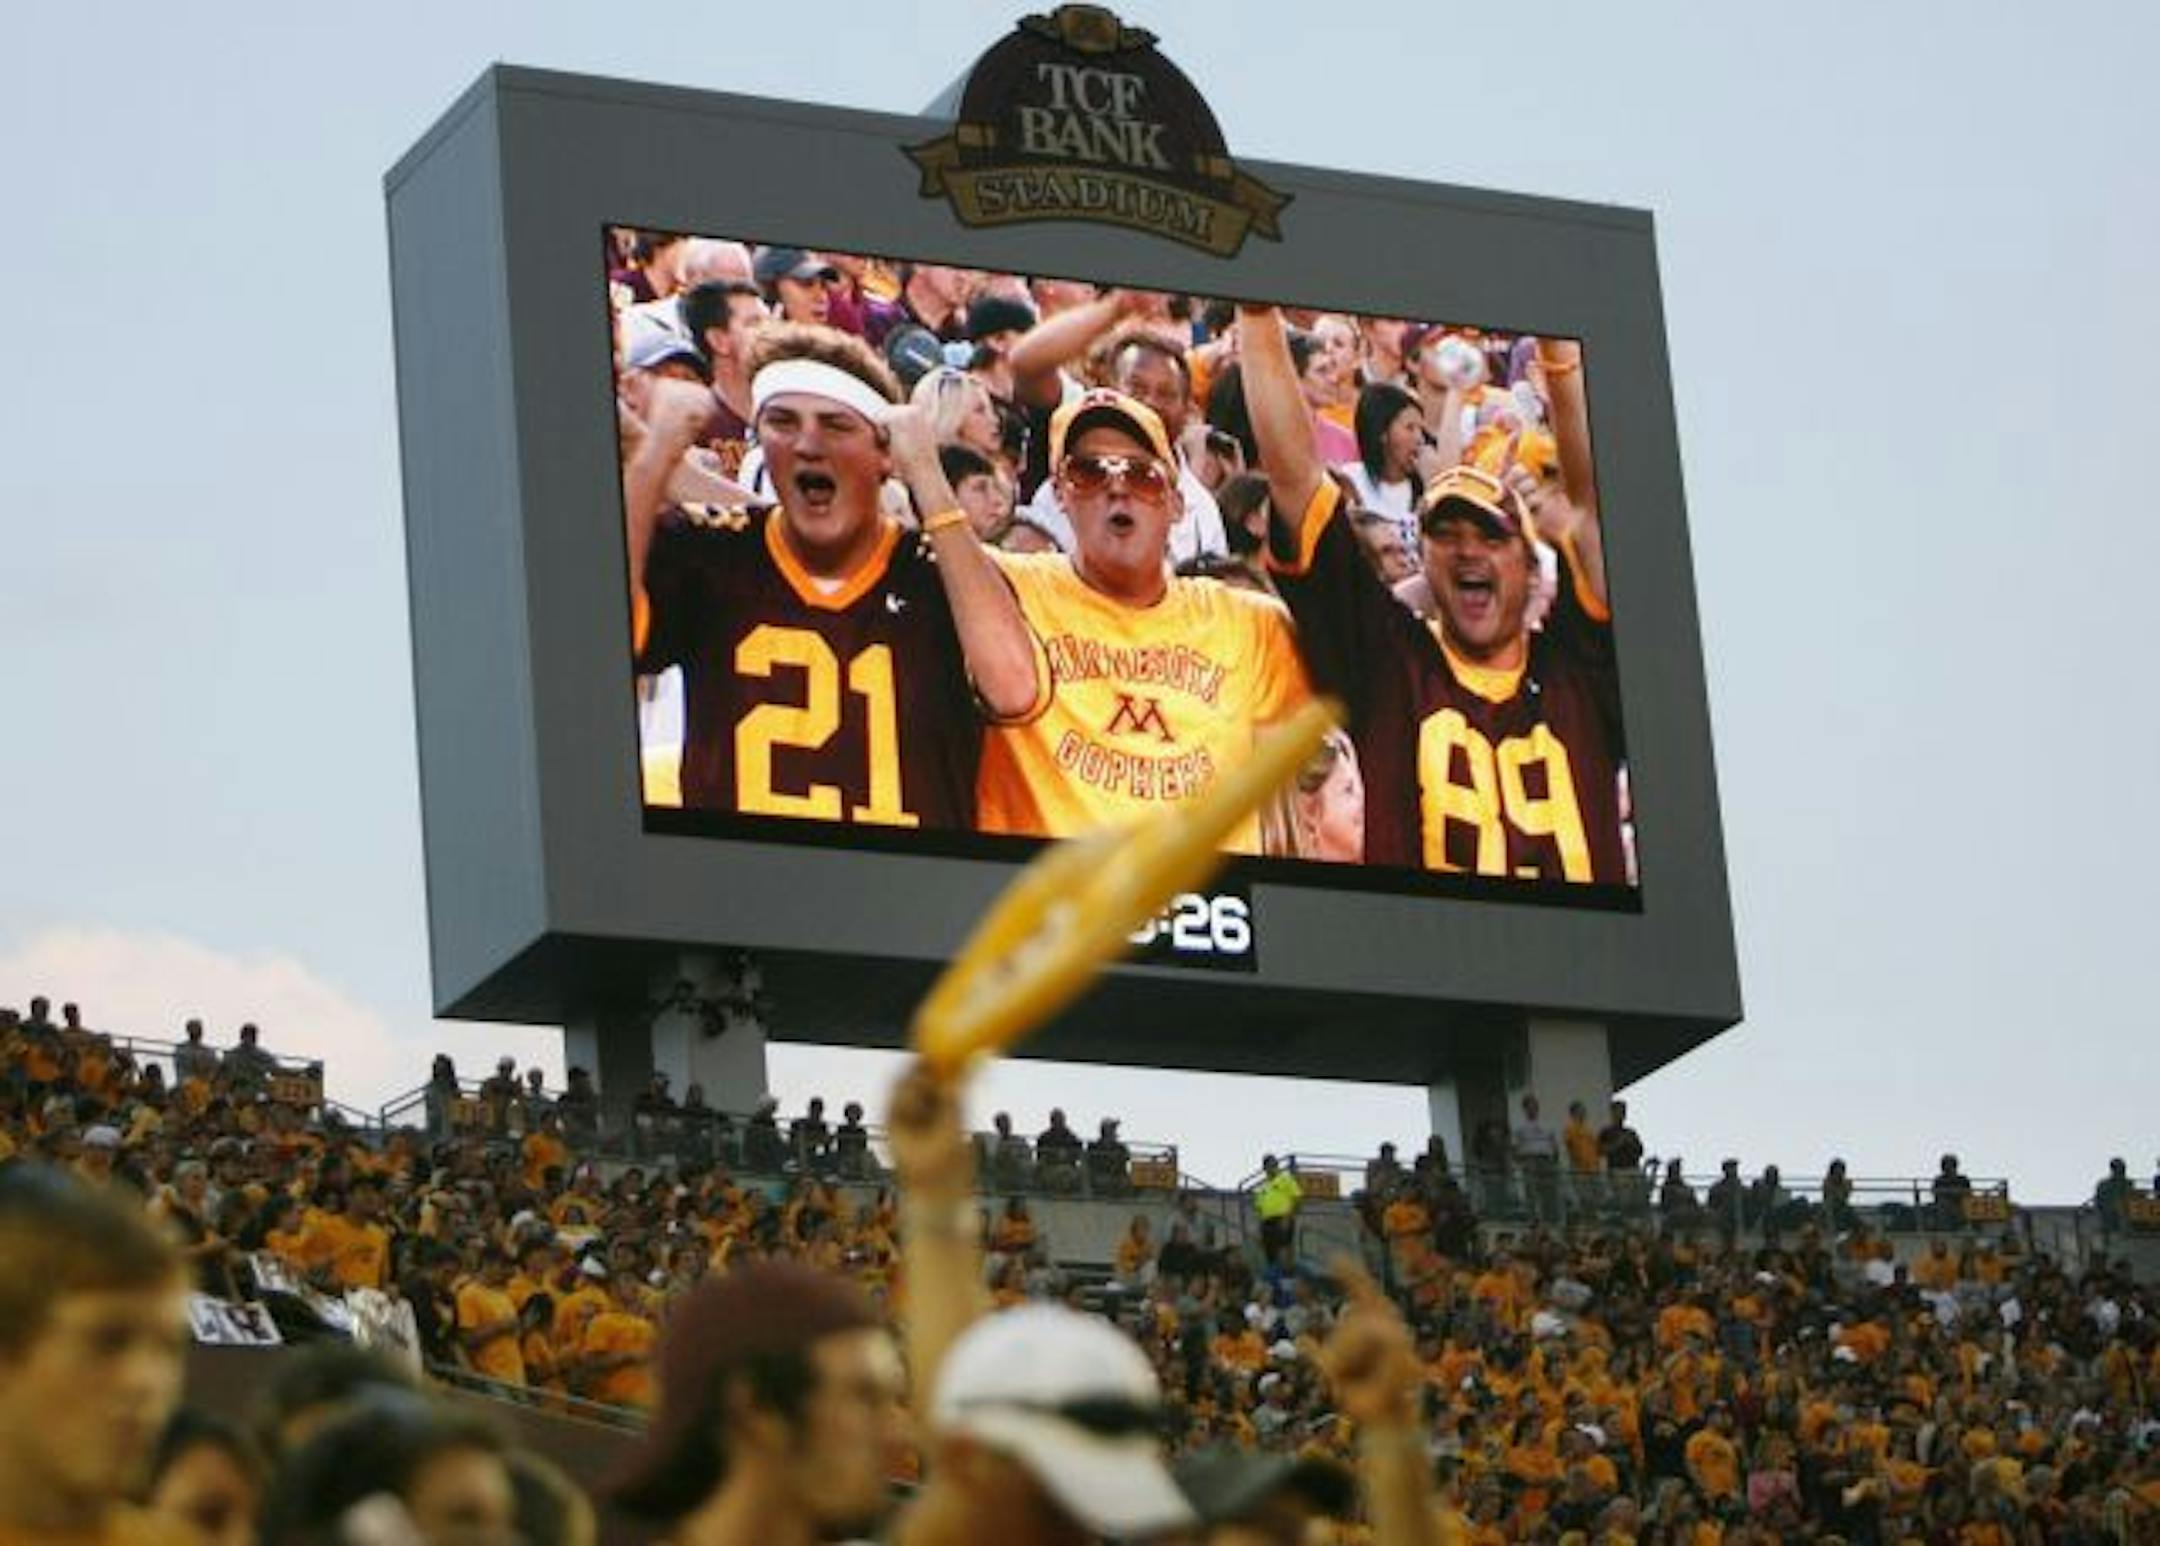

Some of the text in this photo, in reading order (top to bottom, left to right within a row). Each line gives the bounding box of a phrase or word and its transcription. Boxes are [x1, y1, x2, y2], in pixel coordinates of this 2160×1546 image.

[1038, 62, 1147, 121] TCF
[1020, 106, 1170, 171] BANK
[974, 173, 1216, 245] STADIUM
[734, 623, 920, 828] 21
[1418, 707, 1594, 884] 89
